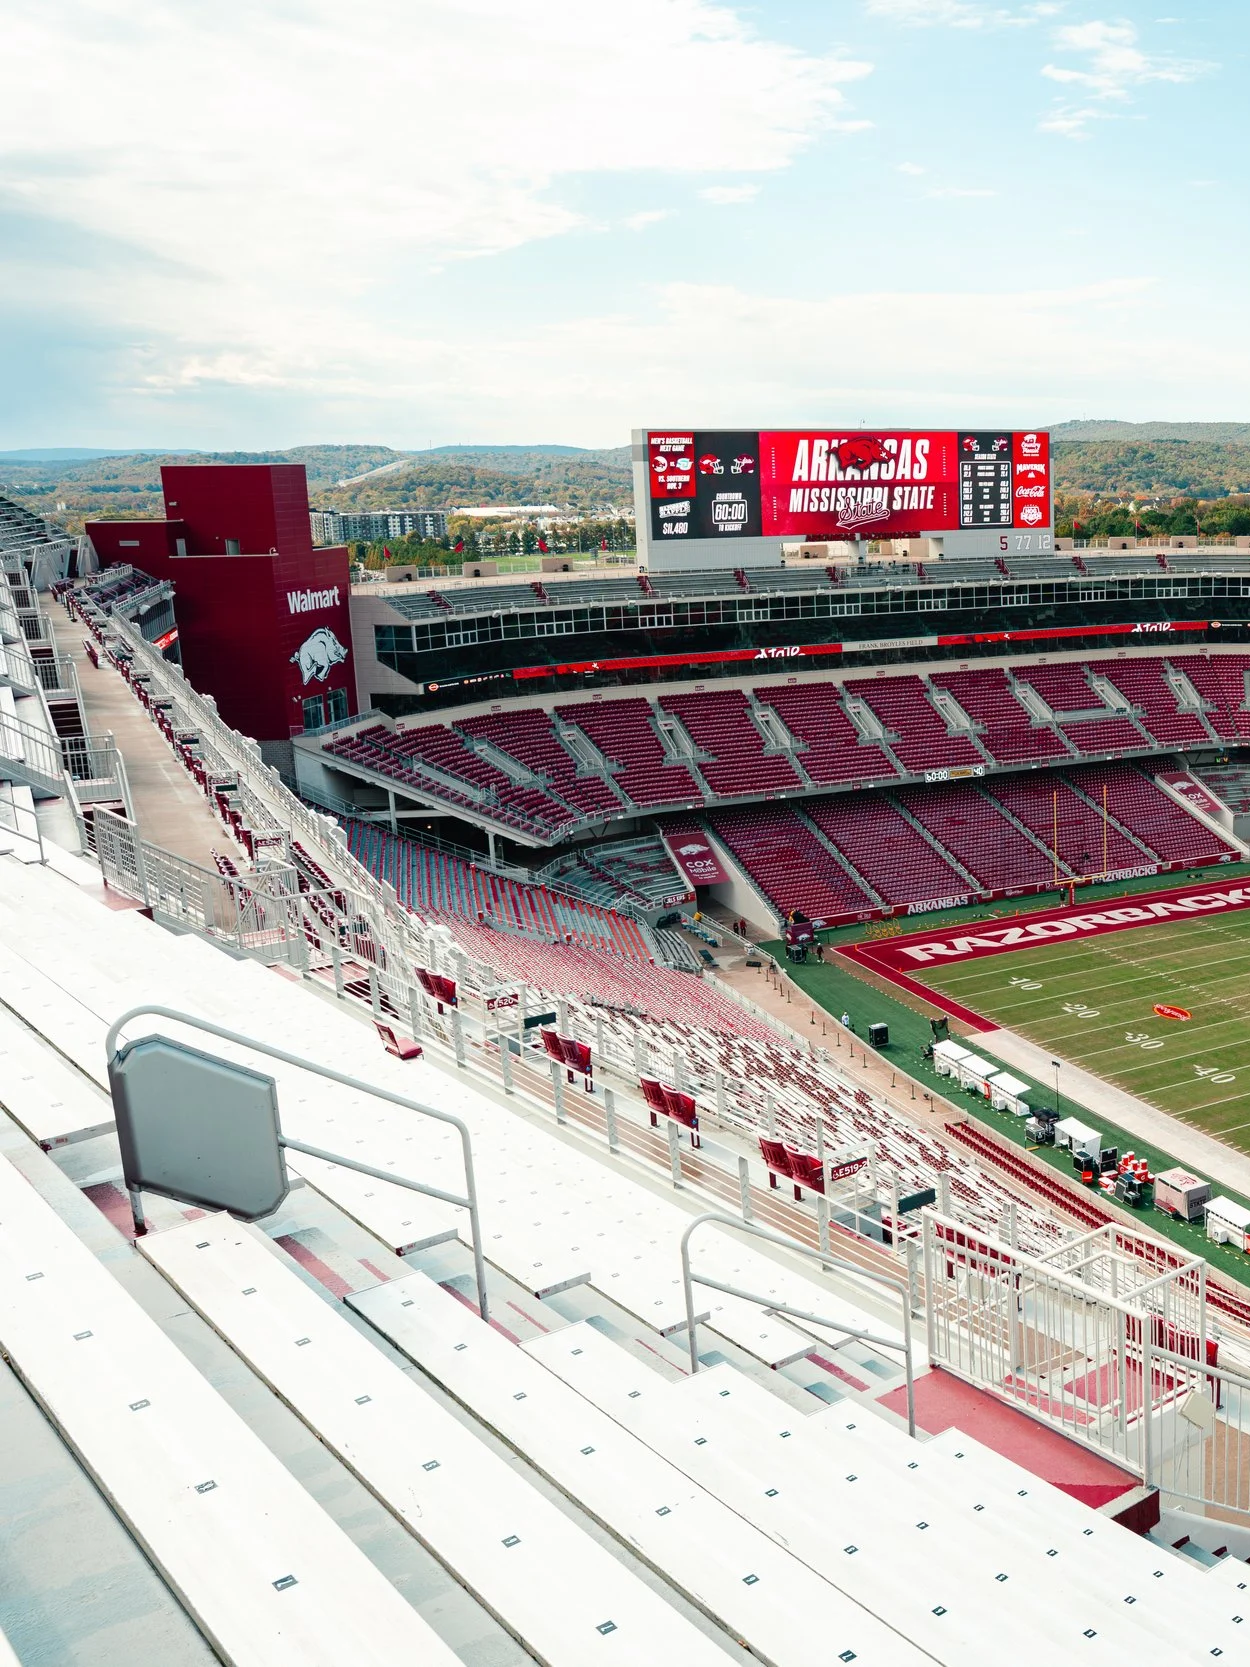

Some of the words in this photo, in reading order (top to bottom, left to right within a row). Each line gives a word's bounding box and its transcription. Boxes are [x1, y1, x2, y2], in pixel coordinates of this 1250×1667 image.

[1016, 464, 1046, 475] MAVERIK
[892, 486, 935, 510] STATE
[715, 504, 745, 520] 60:00
[1000, 536, 1008, 551] 5
[1015, 535, 1032, 550] 77
[1038, 534, 1051, 549] 12
[287, 586, 340, 614] Walmart
[877, 640, 905, 648] BROYLES
[906, 639, 923, 647] FIELD
[926, 771, 948, 781] 60:00
[686, 859, 714, 868] COX
[689, 866, 717, 874] Mobile
[907, 896, 969, 915] ARKANSAS
[1009, 976, 1043, 991] 10
[1063, 1003, 1100, 1018] 20
[1126, 1032, 1164, 1050] 30
[1193, 1065, 1236, 1084] 40
[839, 1161, 868, 1177] E519-2
